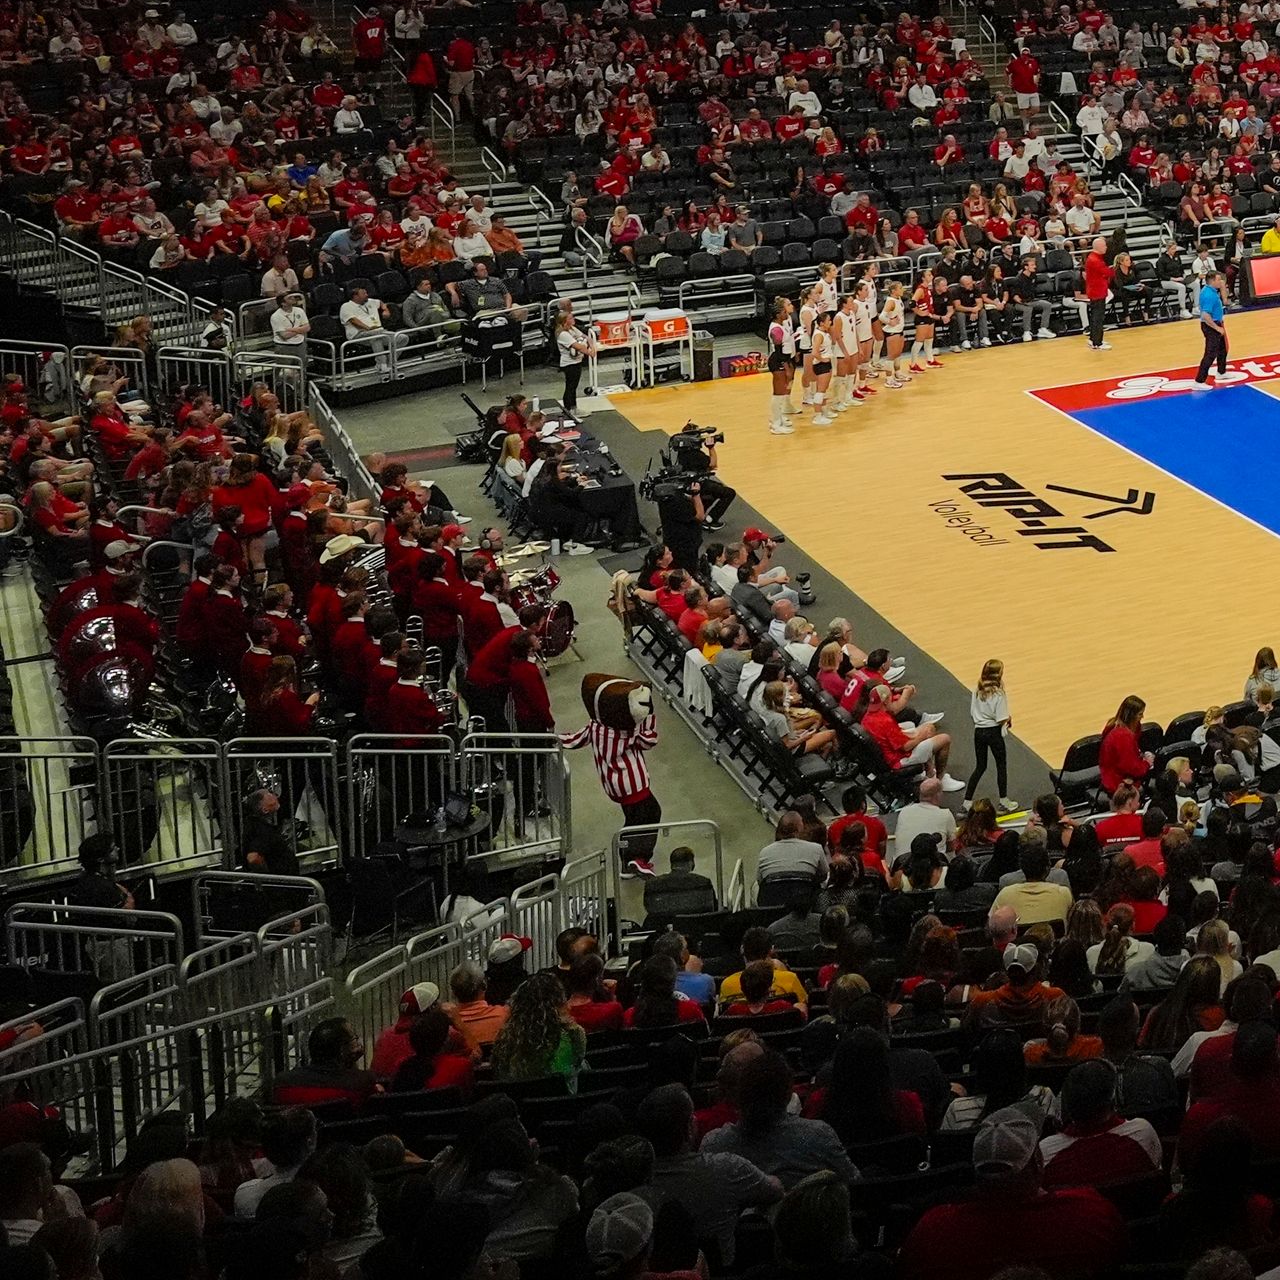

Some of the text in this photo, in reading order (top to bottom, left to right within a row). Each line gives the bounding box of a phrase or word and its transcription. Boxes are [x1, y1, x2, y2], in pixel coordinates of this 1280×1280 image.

[927, 498, 1011, 548] Volleyball
[941, 472, 1118, 553] RIP-IT
[845, 678, 858, 697] 9
